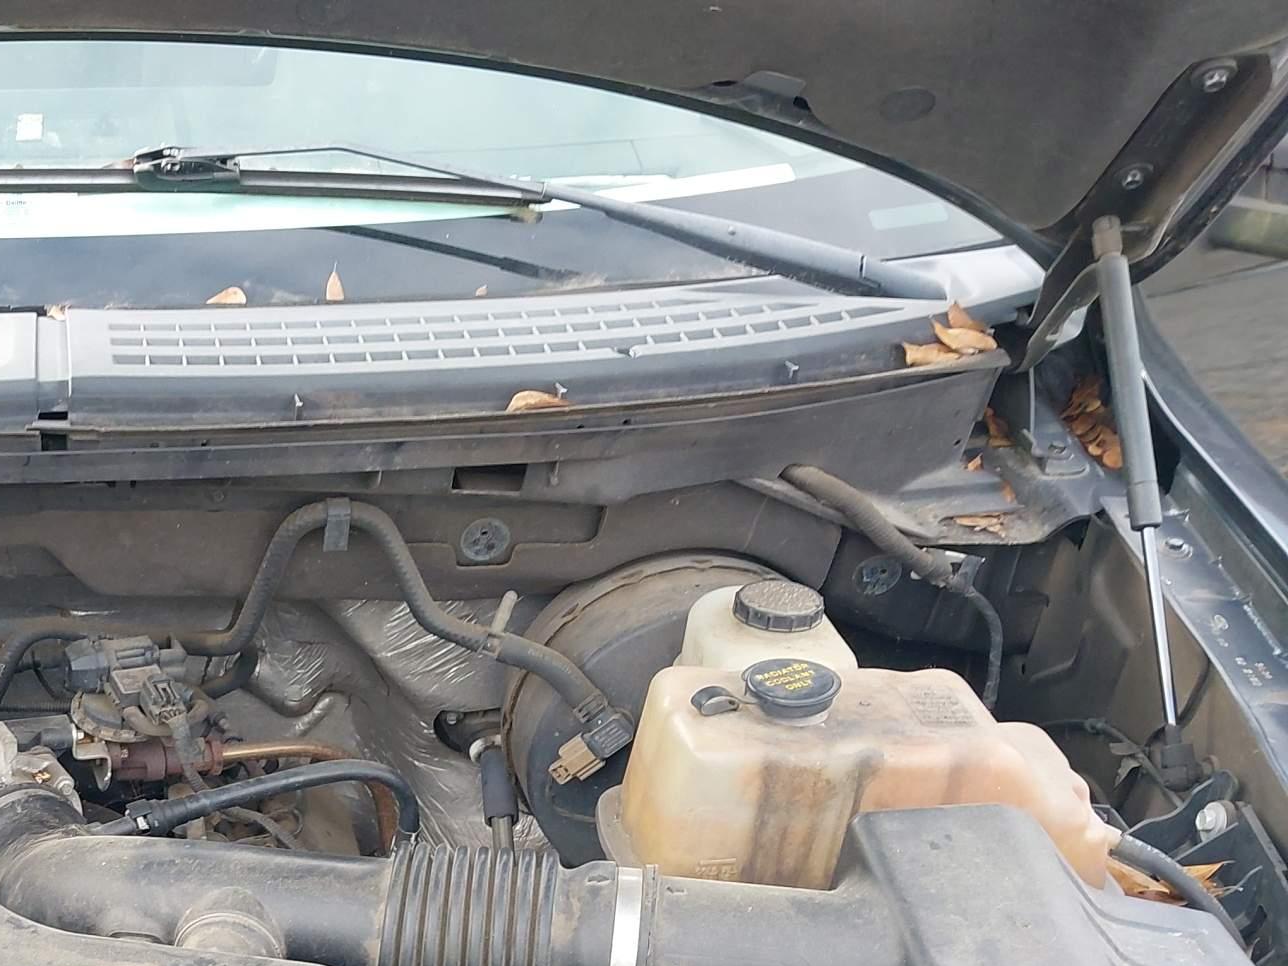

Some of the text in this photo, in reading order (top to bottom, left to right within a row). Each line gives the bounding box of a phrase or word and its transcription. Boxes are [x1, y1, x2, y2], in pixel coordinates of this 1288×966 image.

[755, 663, 809, 681] RADIATOR
[765, 670, 815, 686] COOLANT
[785, 680, 812, 689] ONLY
